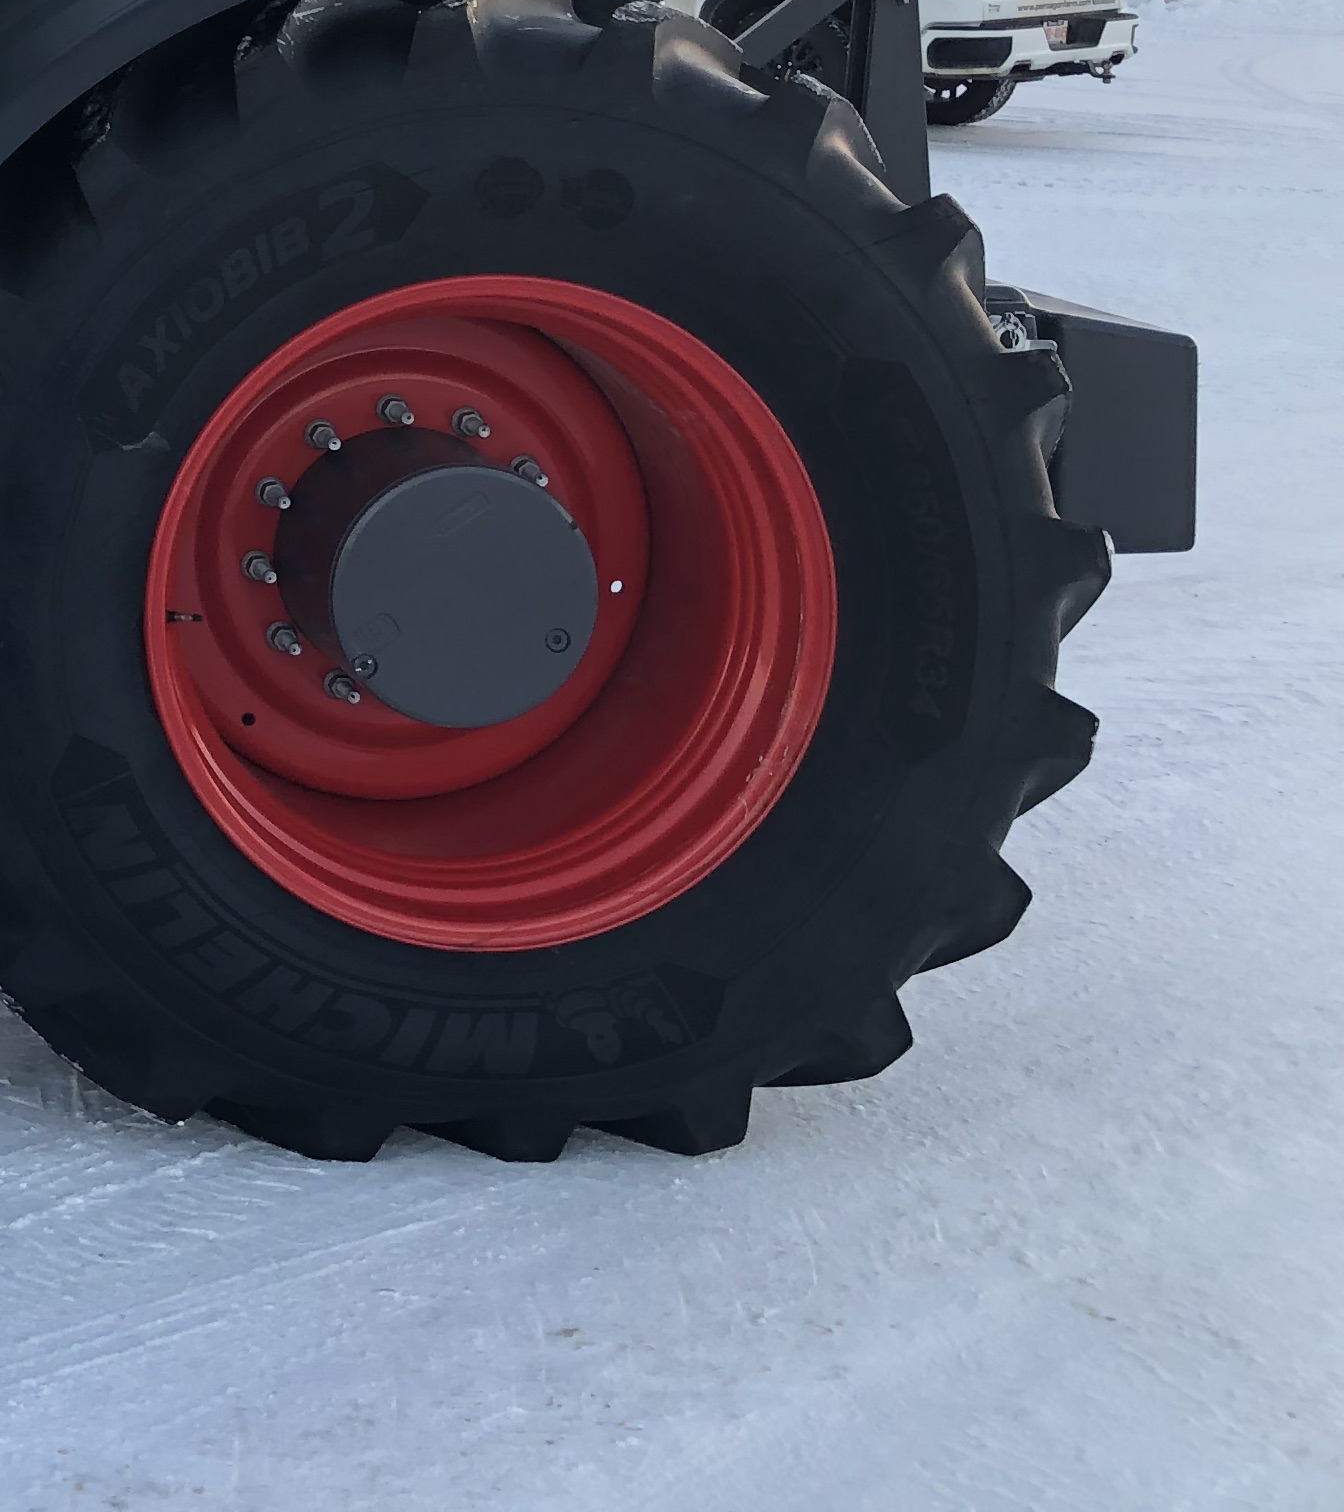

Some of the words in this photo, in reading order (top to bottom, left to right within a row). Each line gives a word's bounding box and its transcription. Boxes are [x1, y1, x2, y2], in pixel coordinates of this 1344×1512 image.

[117, 216, 311, 413] AXIOBIB
[318, 179, 376, 262] 2
[65, 802, 539, 1076] MICHELIN
